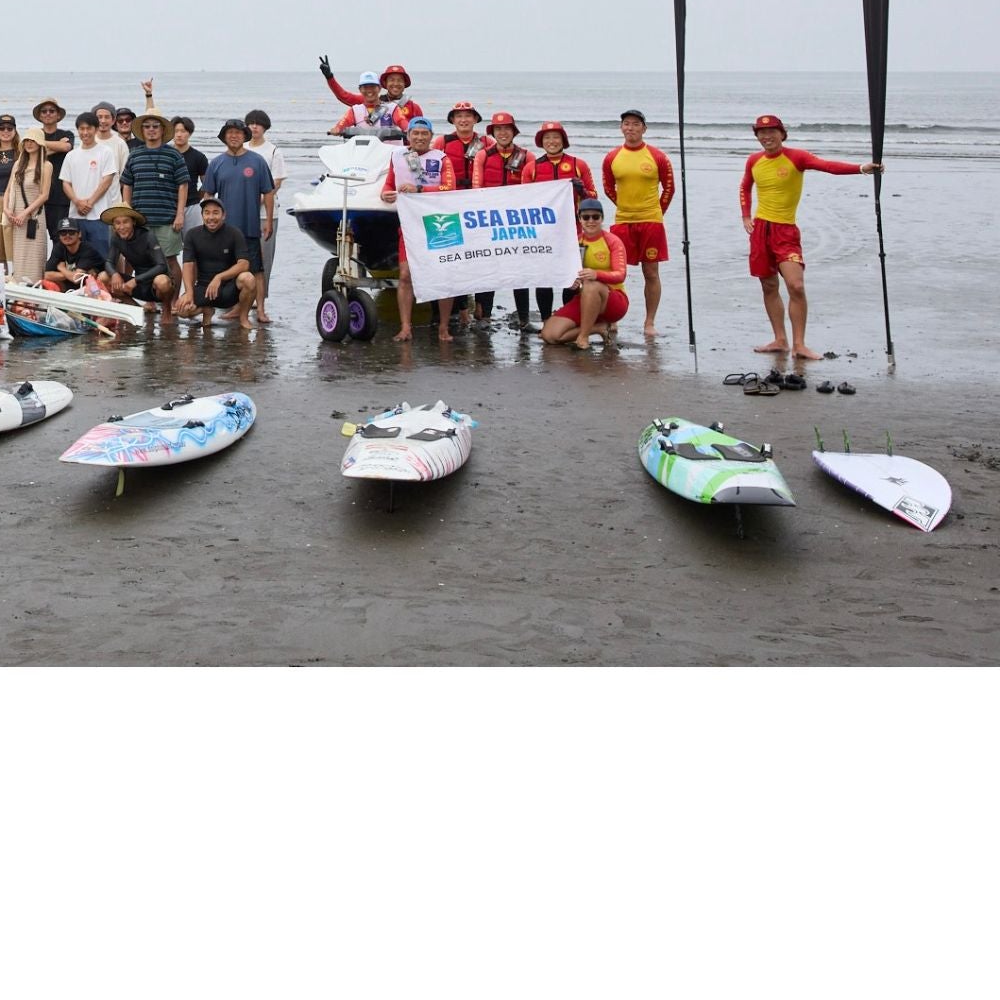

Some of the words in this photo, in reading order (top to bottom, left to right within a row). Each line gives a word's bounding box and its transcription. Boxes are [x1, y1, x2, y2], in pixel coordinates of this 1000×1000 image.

[463, 210, 500, 229] SEA
[505, 207, 557, 226] BIRD
[491, 226, 537, 241] JAPAN
[438, 252, 462, 264] SEA
[464, 248, 492, 260] BIRD
[495, 246, 519, 257] DAY
[522, 245, 553, 254] 2022
